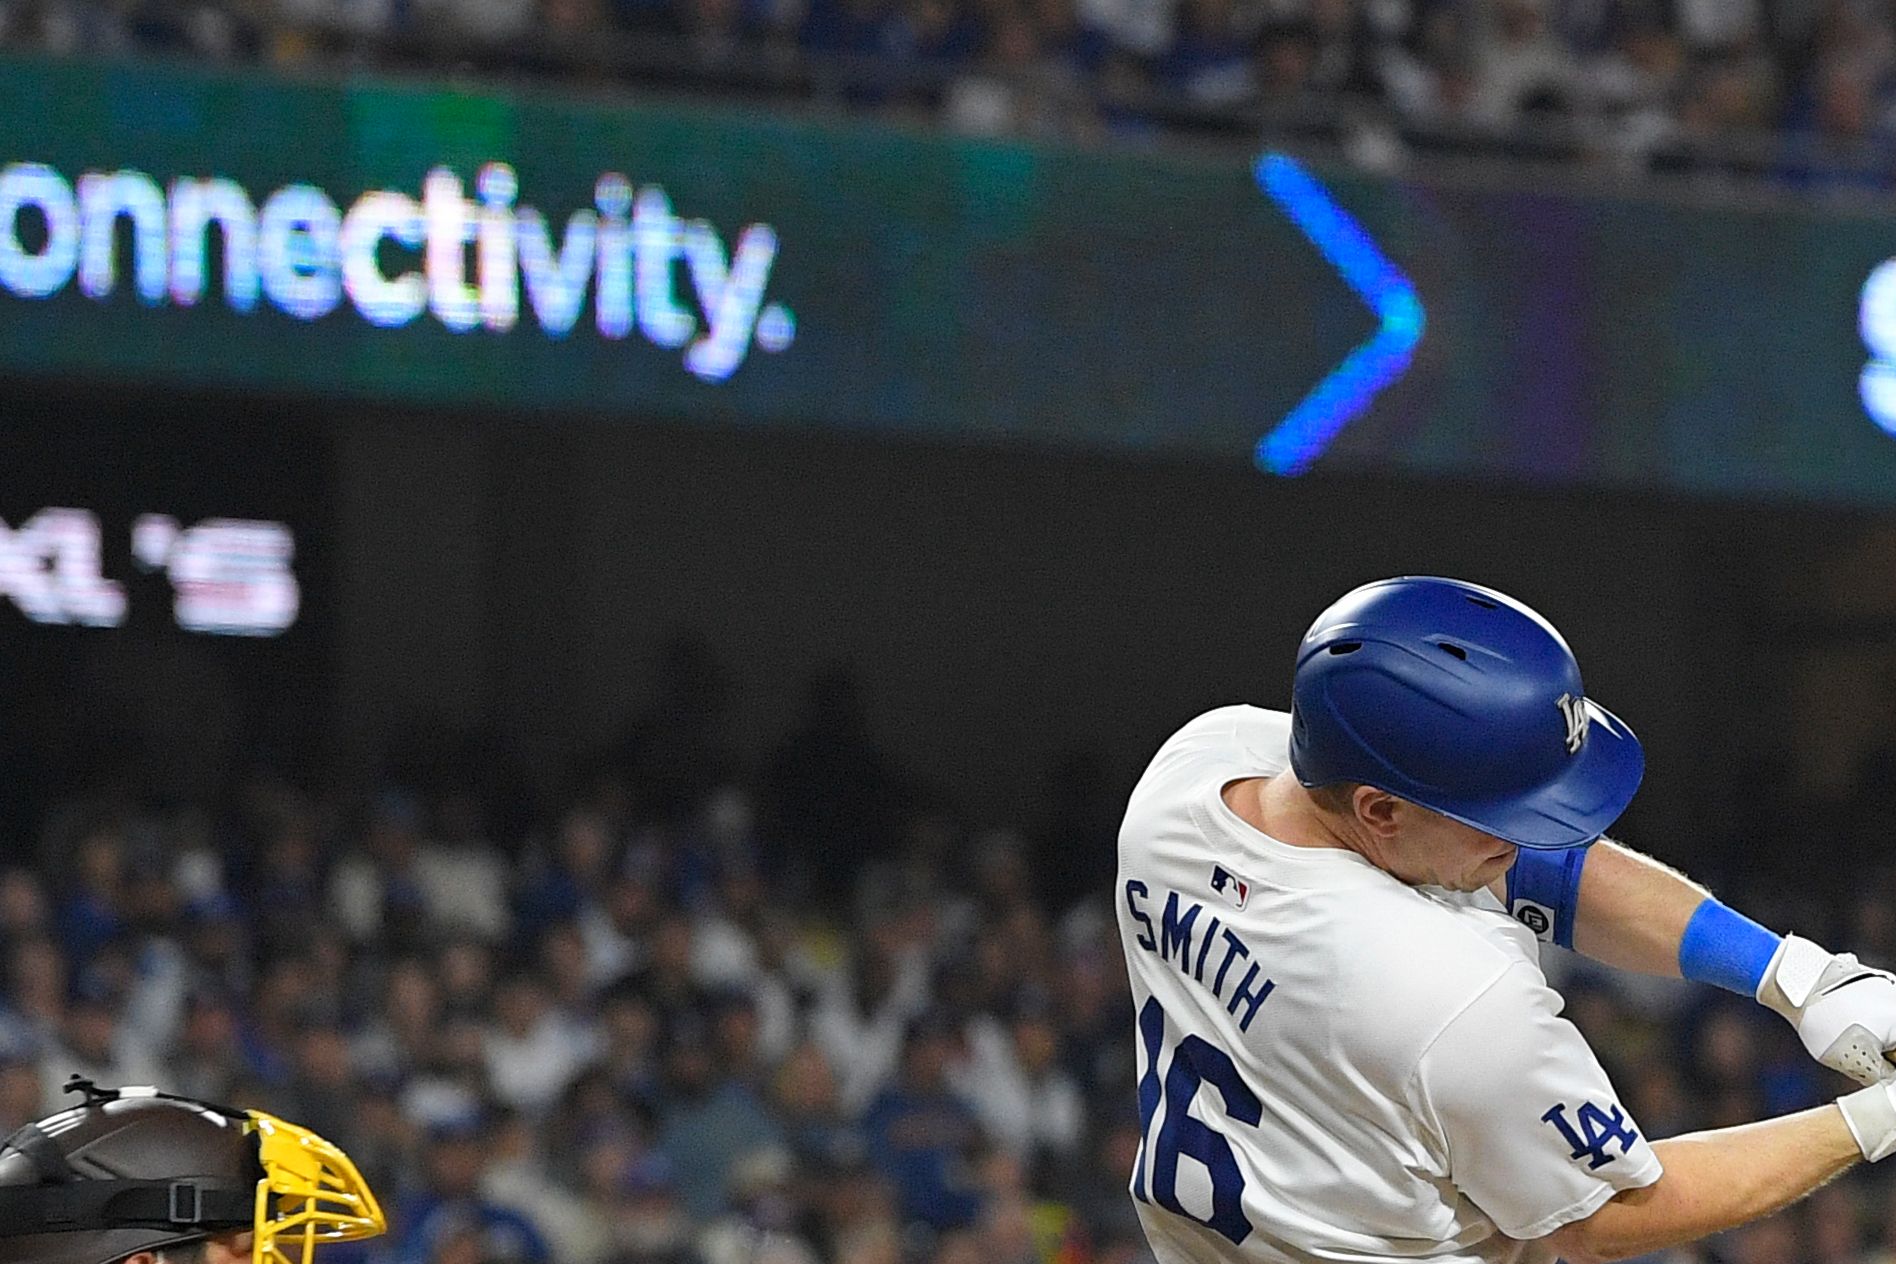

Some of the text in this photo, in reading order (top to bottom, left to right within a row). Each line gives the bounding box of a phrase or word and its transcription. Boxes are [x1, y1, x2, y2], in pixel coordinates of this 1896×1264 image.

[1125, 879, 1276, 1034] SMITH
[1133, 994, 1263, 1246] 16
[1540, 1101, 1639, 1171] LA
